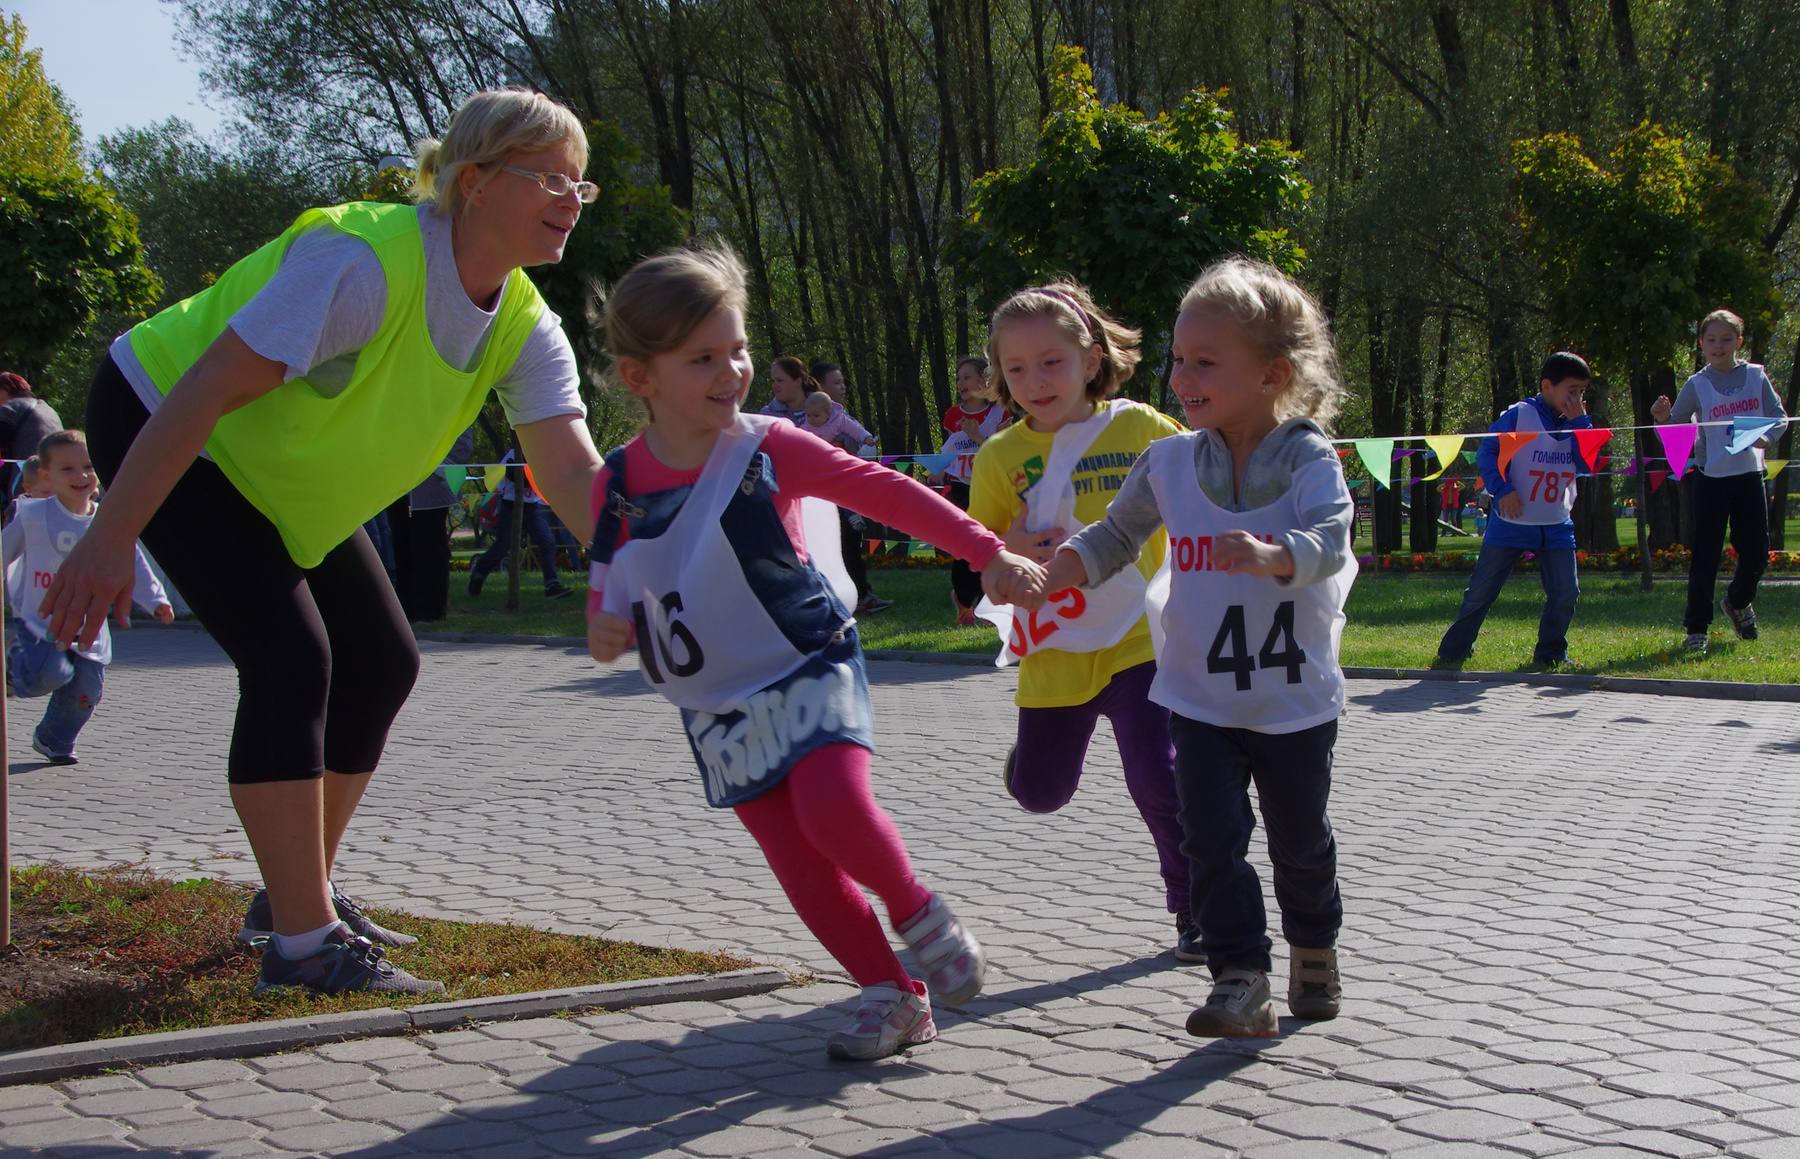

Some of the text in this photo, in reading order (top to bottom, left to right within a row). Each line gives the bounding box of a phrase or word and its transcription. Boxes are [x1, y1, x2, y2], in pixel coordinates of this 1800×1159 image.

[1708, 397, 1760, 420] ГОЛЬЯНОВО
[1072, 478, 1094, 496] РУГ
[1529, 469, 1575, 504] 787
[631, 590, 705, 684] 16
[1207, 601, 1306, 691] 44
